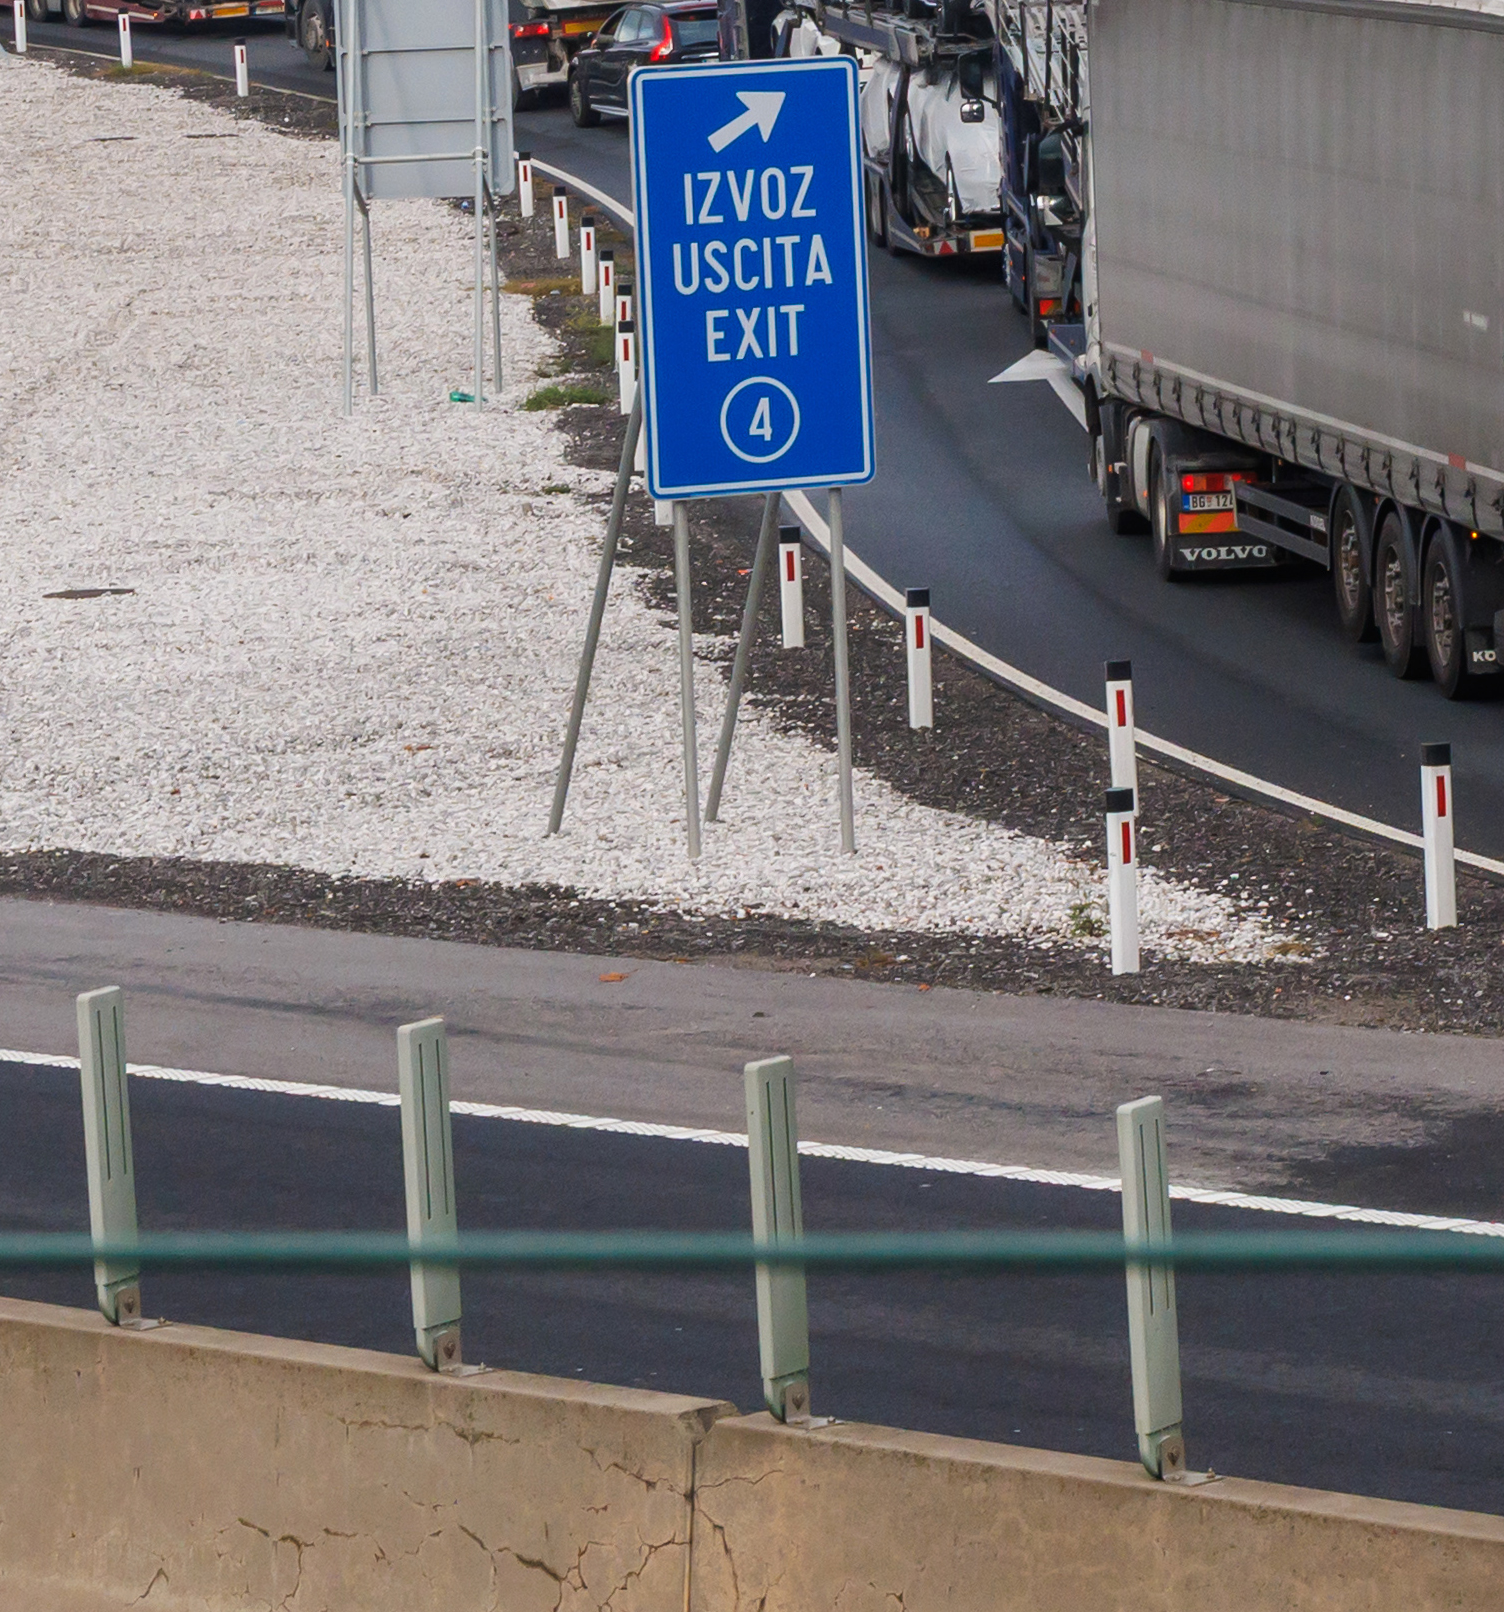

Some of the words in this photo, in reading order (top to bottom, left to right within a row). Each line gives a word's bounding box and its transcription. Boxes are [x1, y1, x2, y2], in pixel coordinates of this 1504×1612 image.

[683, 165, 818, 226] IZVOZ
[672, 233, 833, 296] USCITA
[705, 303, 805, 363] EXIT
[748, 396, 773, 442] 4
[1191, 495, 1206, 509] BG
[1179, 545, 1268, 562] VOLVO
